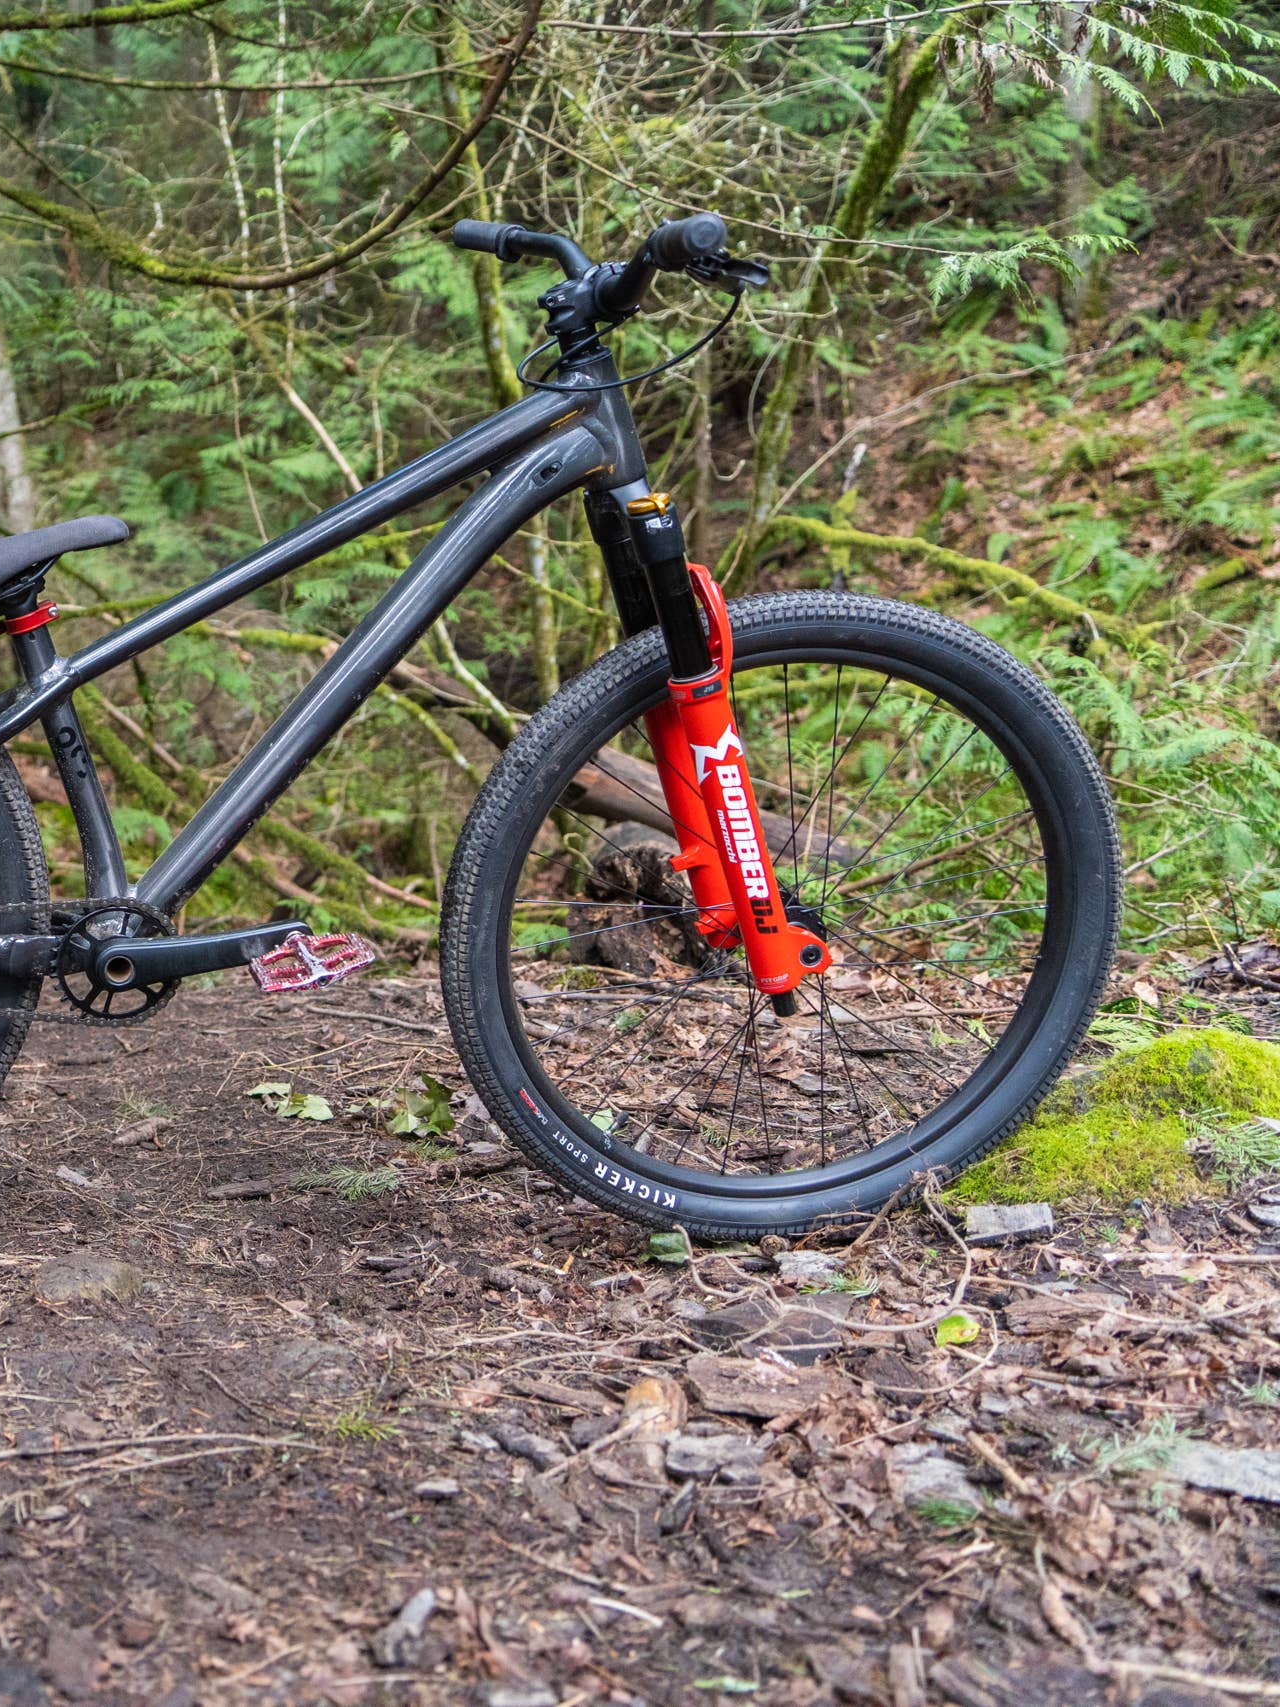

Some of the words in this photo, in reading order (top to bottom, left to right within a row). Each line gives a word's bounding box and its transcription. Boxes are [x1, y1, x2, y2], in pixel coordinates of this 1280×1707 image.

[716, 808, 738, 864] marzocchi
[716, 765, 769, 899] BOMBER
[751, 897, 778, 935] DJ
[552, 1130, 589, 1163] SPORT
[594, 1161, 677, 1209] KICKER
